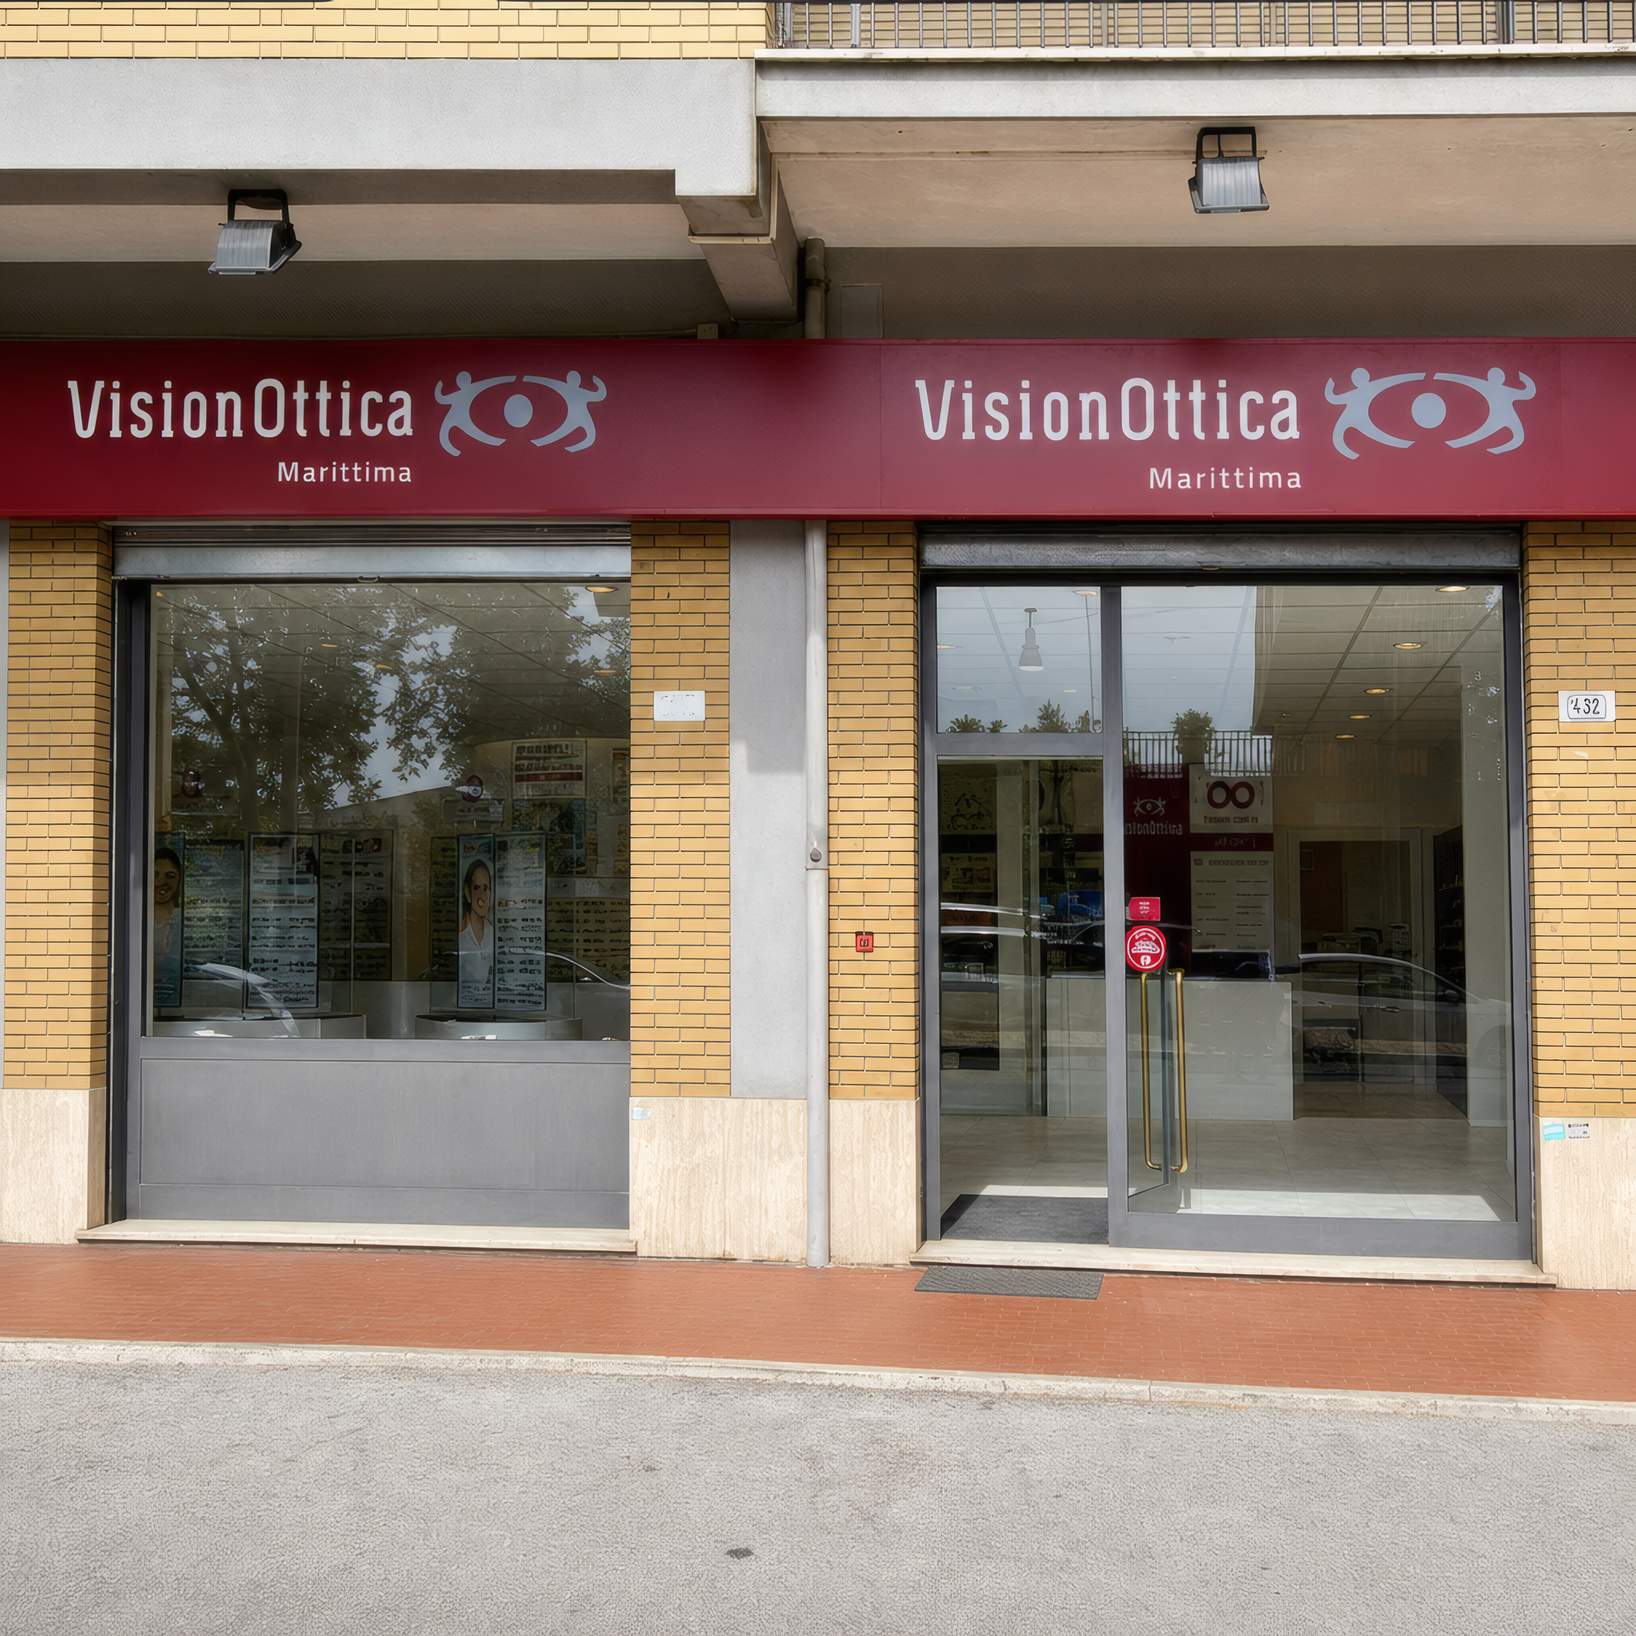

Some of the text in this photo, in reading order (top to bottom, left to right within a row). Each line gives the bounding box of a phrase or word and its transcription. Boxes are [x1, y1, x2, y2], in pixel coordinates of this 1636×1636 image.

[67, 378, 413, 439] VisionOttica
[915, 377, 1300, 441] VisionOttica
[277, 462, 412, 483] Marittima
[1149, 466, 1301, 489] Marittima
[1572, 698, 1600, 715] 432
